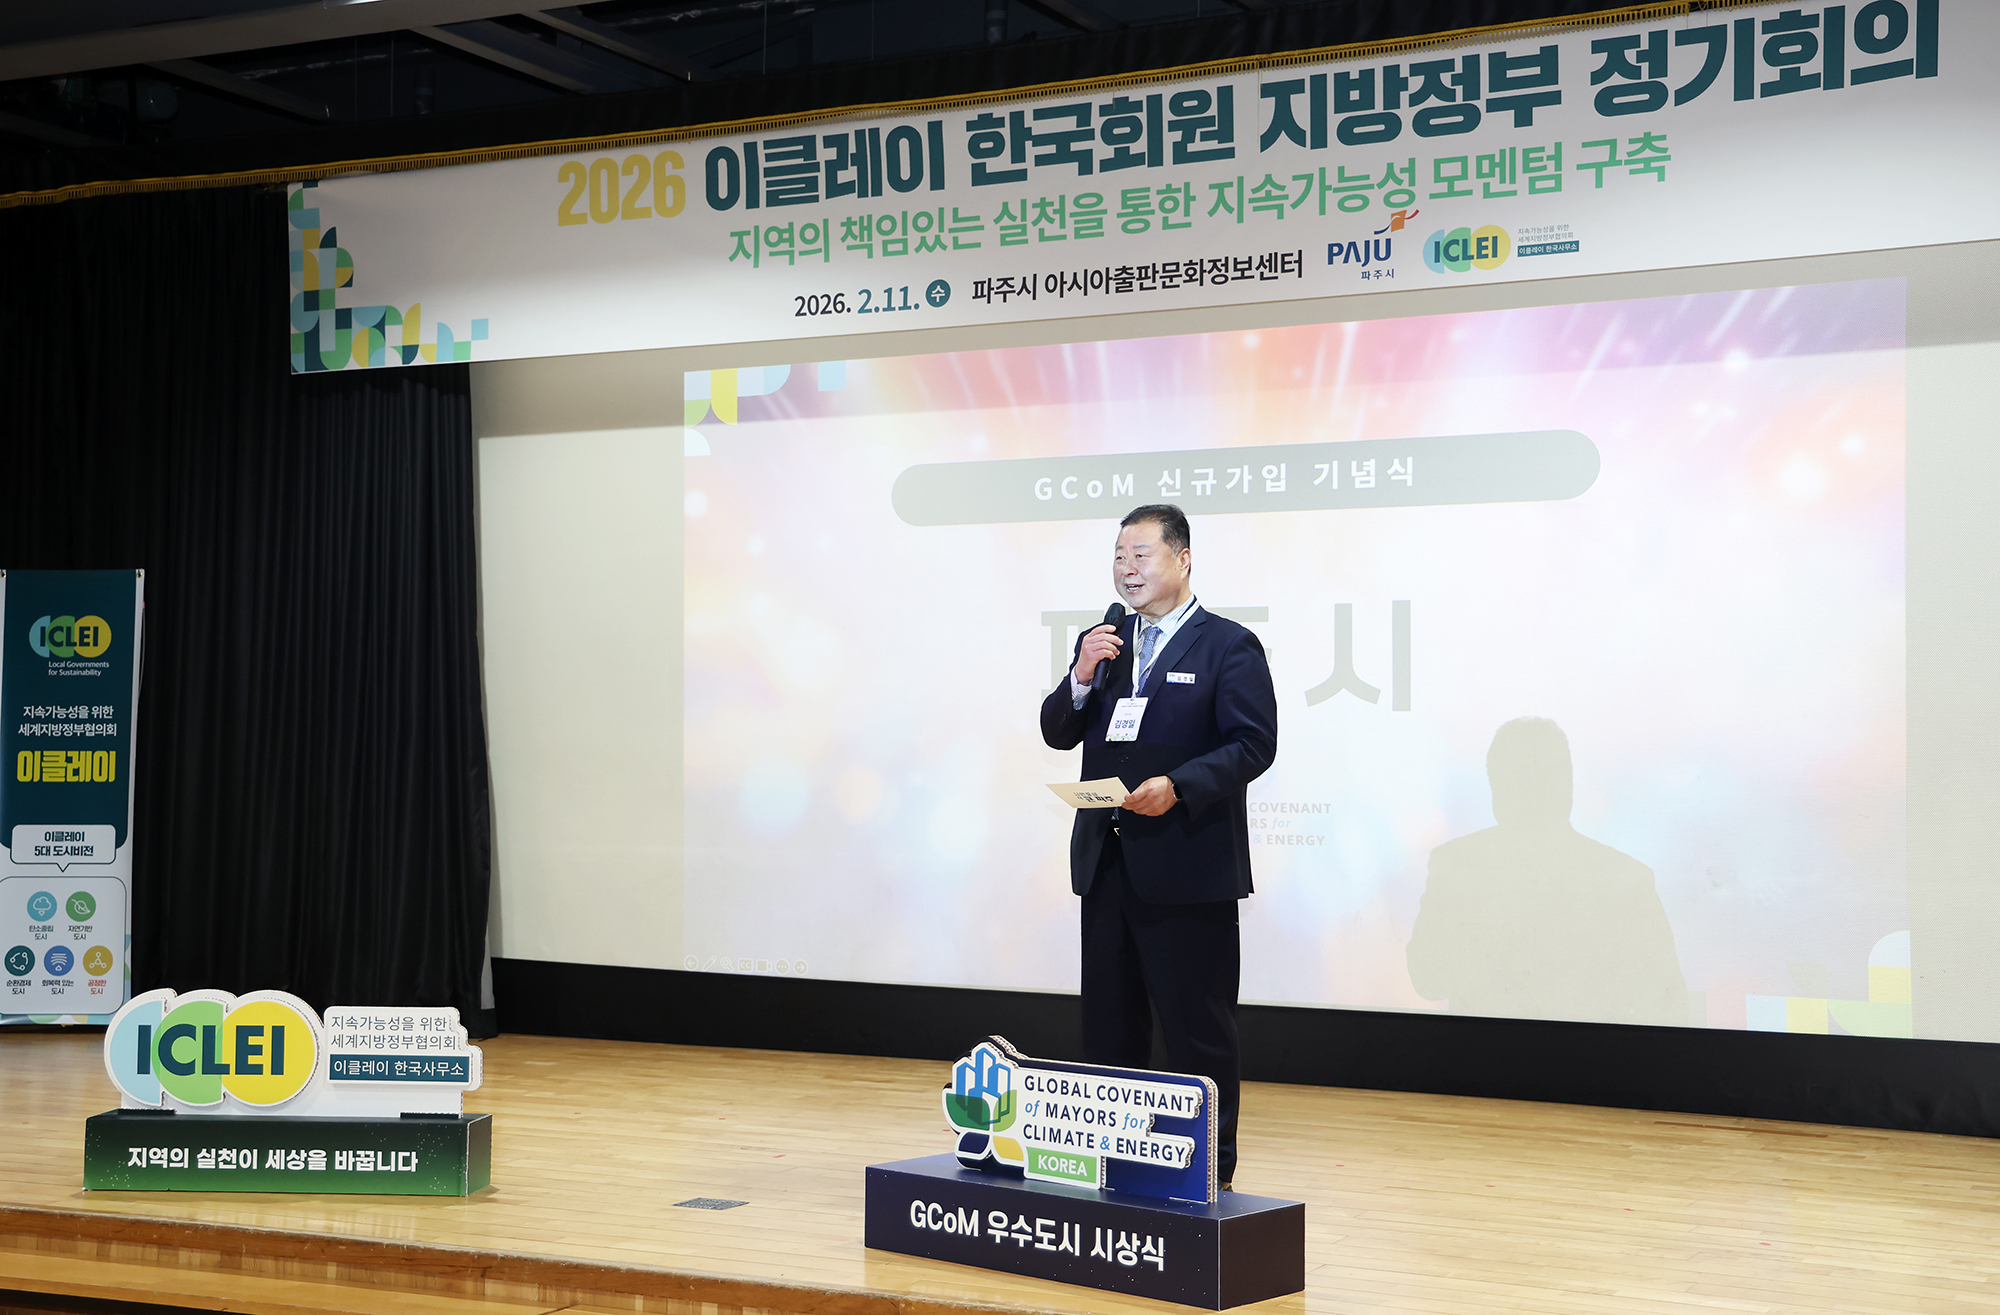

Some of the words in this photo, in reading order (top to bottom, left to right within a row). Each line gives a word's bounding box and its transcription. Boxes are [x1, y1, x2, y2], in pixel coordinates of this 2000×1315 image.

[556, 150, 687, 227] 2026
[704, 119, 946, 212] 이클레이
[966, 84, 1236, 188] 한국회원
[1259, 43, 1562, 154] 지방정부
[1588, 0, 1939, 118] 정기회의
[727, 218, 830, 269] 지역의
[839, 207, 986, 259] 책임있는
[991, 190, 1108, 246] 실천을
[1115, 183, 1197, 235] 통한
[1207, 156, 1417, 225] 지속가능성
[1428, 142, 1564, 202] 모멘텀
[1576, 131, 1672, 188] 구축
[1327, 238, 1391, 267] PAJU
[1434, 235, 1498, 263] ICLEI
[1518, 245, 1544, 255] 이클레이
[1546, 243, 1577, 253] 한국사무소
[794, 292, 852, 318] 2026.
[857, 286, 921, 315] 2.11.
[930, 285, 946, 302] 수
[971, 273, 1038, 303] 파주시
[1044, 249, 1302, 298] 아시아출판문화정보센터
[1361, 268, 1394, 281] 파주시
[1034, 474, 1134, 501] GCoM
[1157, 463, 1288, 496] 신규가입
[1313, 457, 1415, 489] 기념식
[40, 626, 99, 647] ICLEI
[23, 705, 89, 719] 지속가능성을
[91, 705, 114, 719] 위한
[18, 723, 117, 736] 세계지방정부협의회
[17, 750, 116, 782] 이클레이
[1249, 802, 1331, 814] COVENANT
[1272, 818, 1291, 830] for
[44, 831, 85, 843] 이클레이
[1267, 835, 1325, 846] ENERGY
[34, 846, 51, 856] 5대
[53, 846, 94, 857] 도시비전
[331, 1015, 415, 1030] 지속가능성을
[419, 1016, 447, 1032] 위한
[136, 1024, 285, 1076] ICLEI
[330, 1034, 457, 1050] 세계지방정부협의회
[333, 1060, 389, 1076] 이클레이
[394, 1060, 464, 1077] 한국사무소
[1024, 1076, 1091, 1100] GLOBAL
[1096, 1084, 1194, 1113] COVENANT
[1025, 1099, 1040, 1115] of
[1046, 1103, 1117, 1127] MAYORS
[1122, 1112, 1146, 1131] for
[1023, 1124, 1095, 1149] CLIMATE
[1100, 1135, 1110, 1151] &
[1116, 1137, 1186, 1164] ENERGY
[128, 1147, 189, 1169] 지역의
[196, 1148, 258, 1170] 실천이
[265, 1149, 327, 1171] 세상을
[334, 1150, 418, 1172] 바꿉니다
[1037, 1155, 1088, 1177] KOREA
[910, 1200, 979, 1237] GCoM
[987, 1210, 1080, 1256] 우수도시
[1091, 1227, 1164, 1271] 시상식
